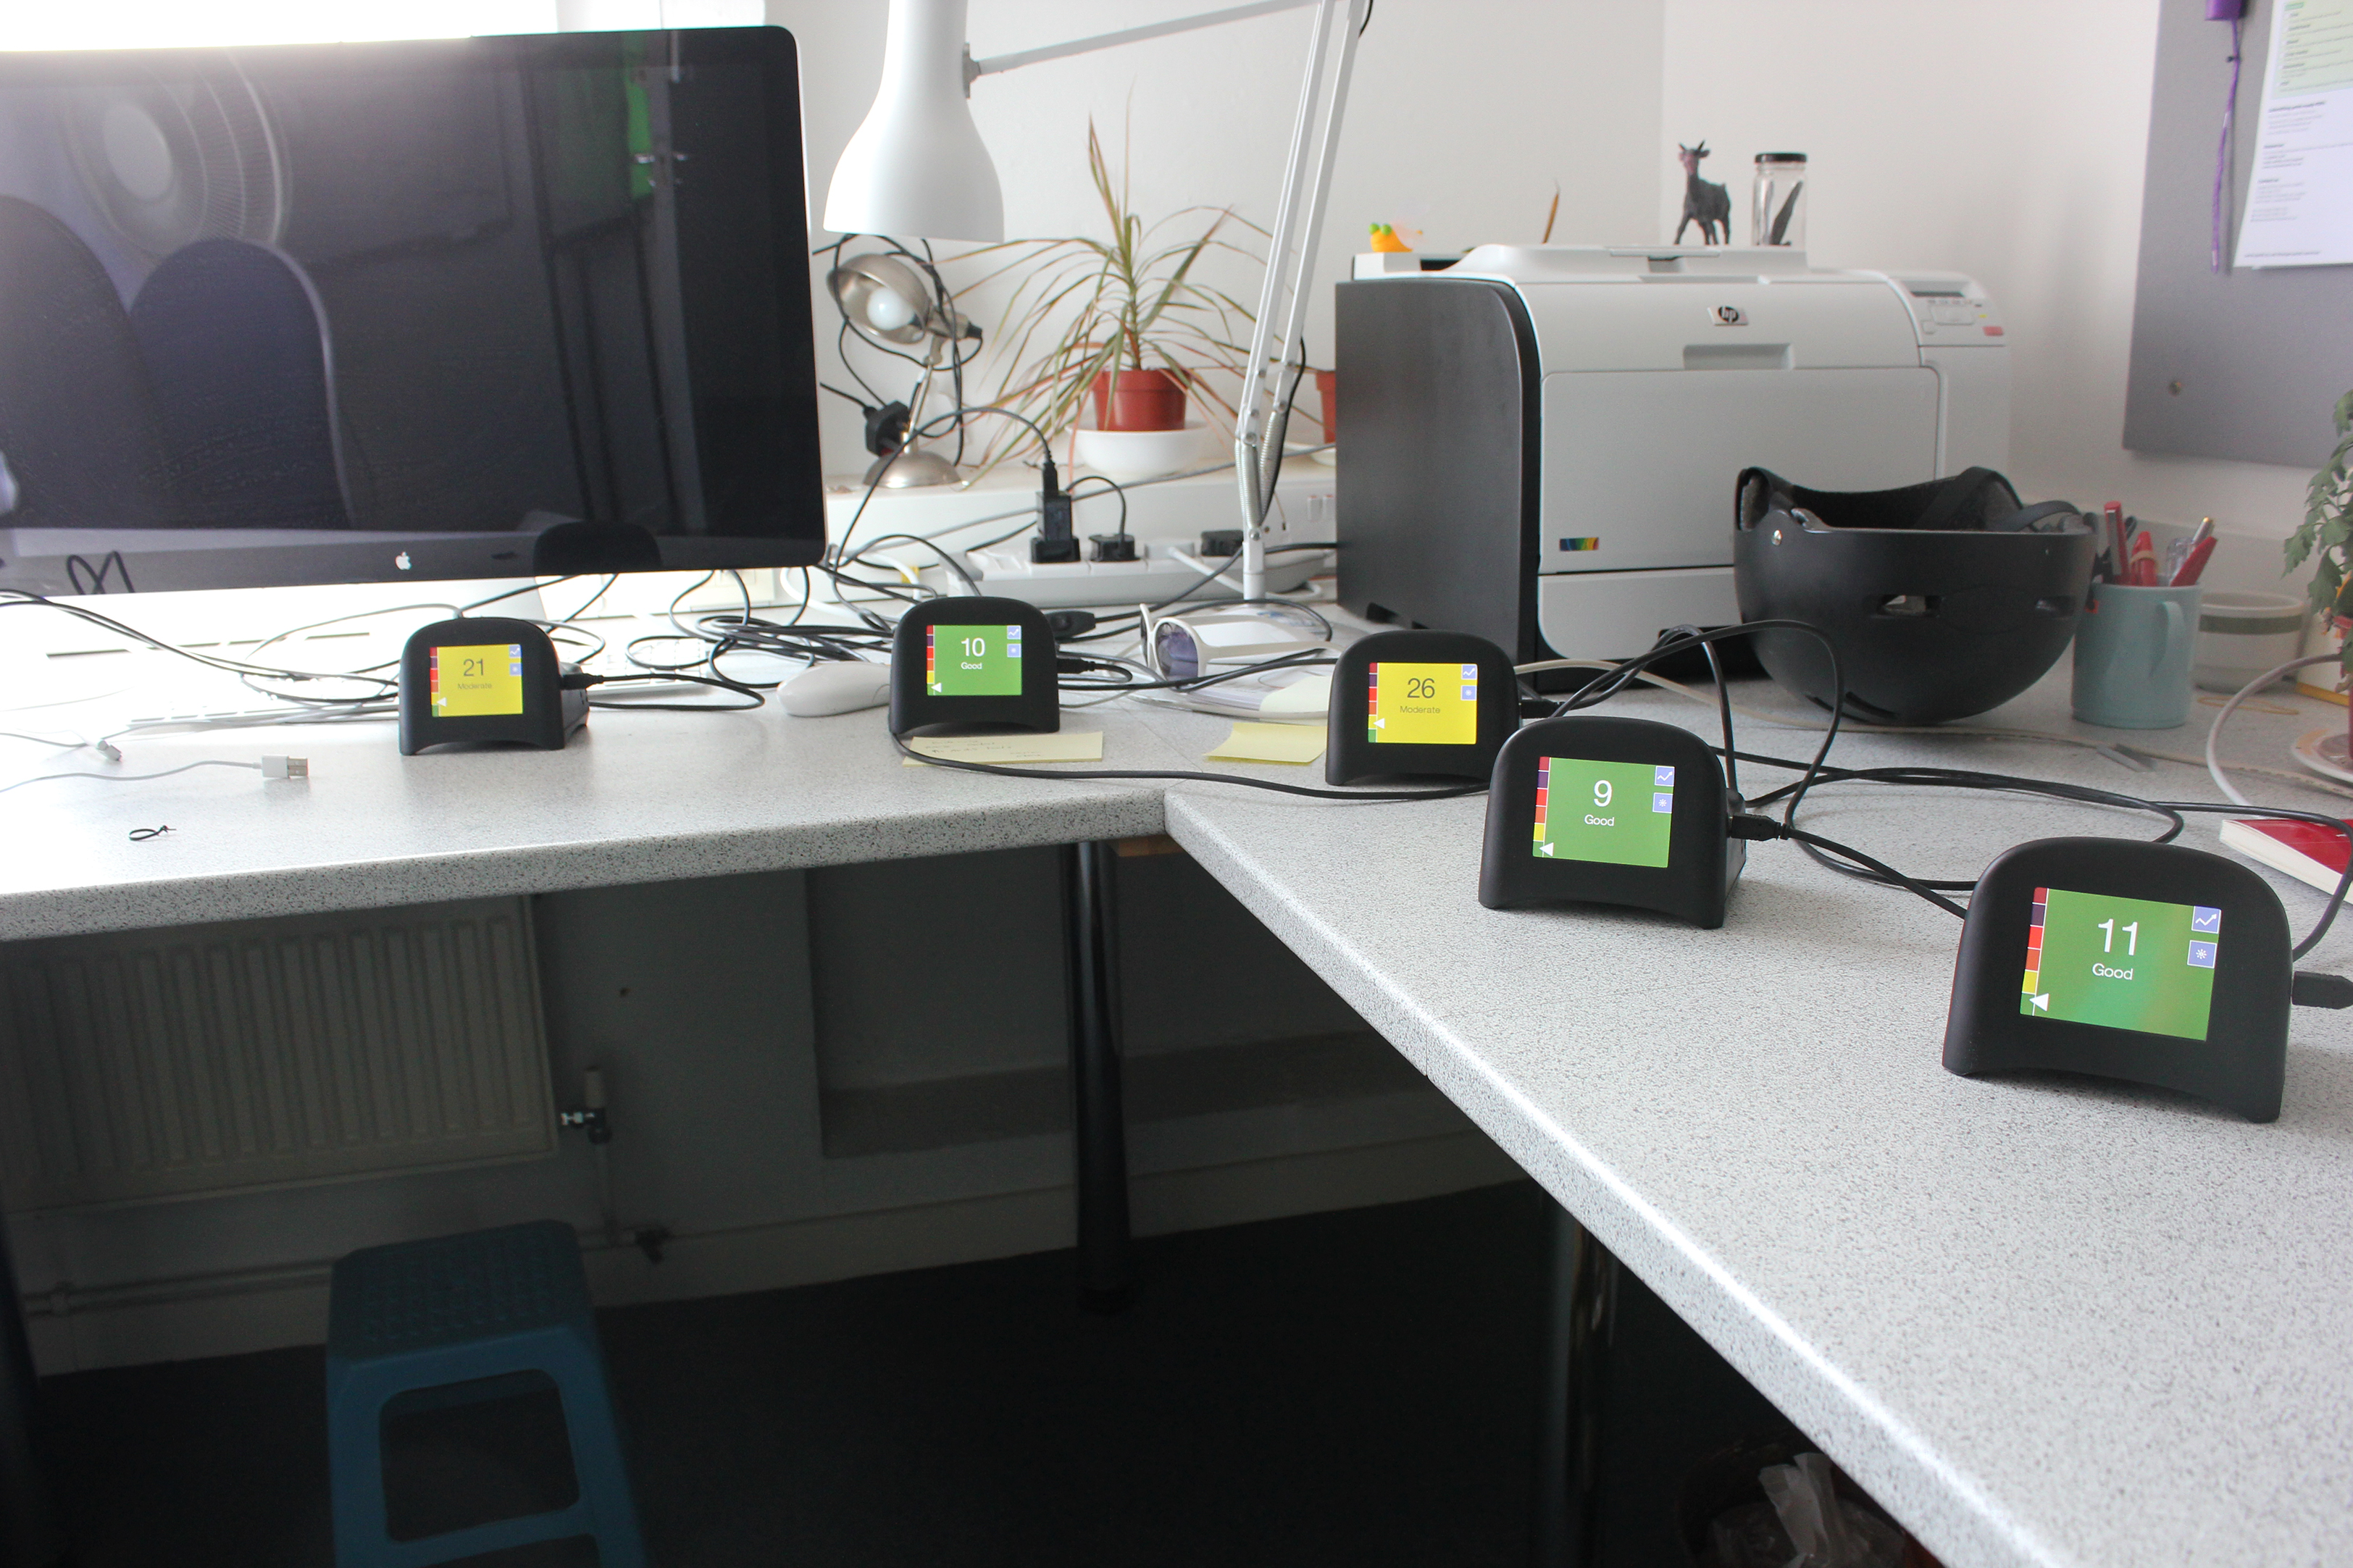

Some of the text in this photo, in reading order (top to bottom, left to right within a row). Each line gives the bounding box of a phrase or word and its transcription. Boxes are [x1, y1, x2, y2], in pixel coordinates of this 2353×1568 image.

[1719, 305, 1738, 324] hp
[961, 637, 985, 657] 10
[463, 658, 485, 676] 21
[1407, 678, 1435, 699] 26
[1400, 705, 1440, 714] Moderate
[1593, 779, 1613, 808] 9
[1584, 814, 1615, 827] Good
[2097, 918, 2138, 956] 11
[2091, 963, 2133, 981] Good
